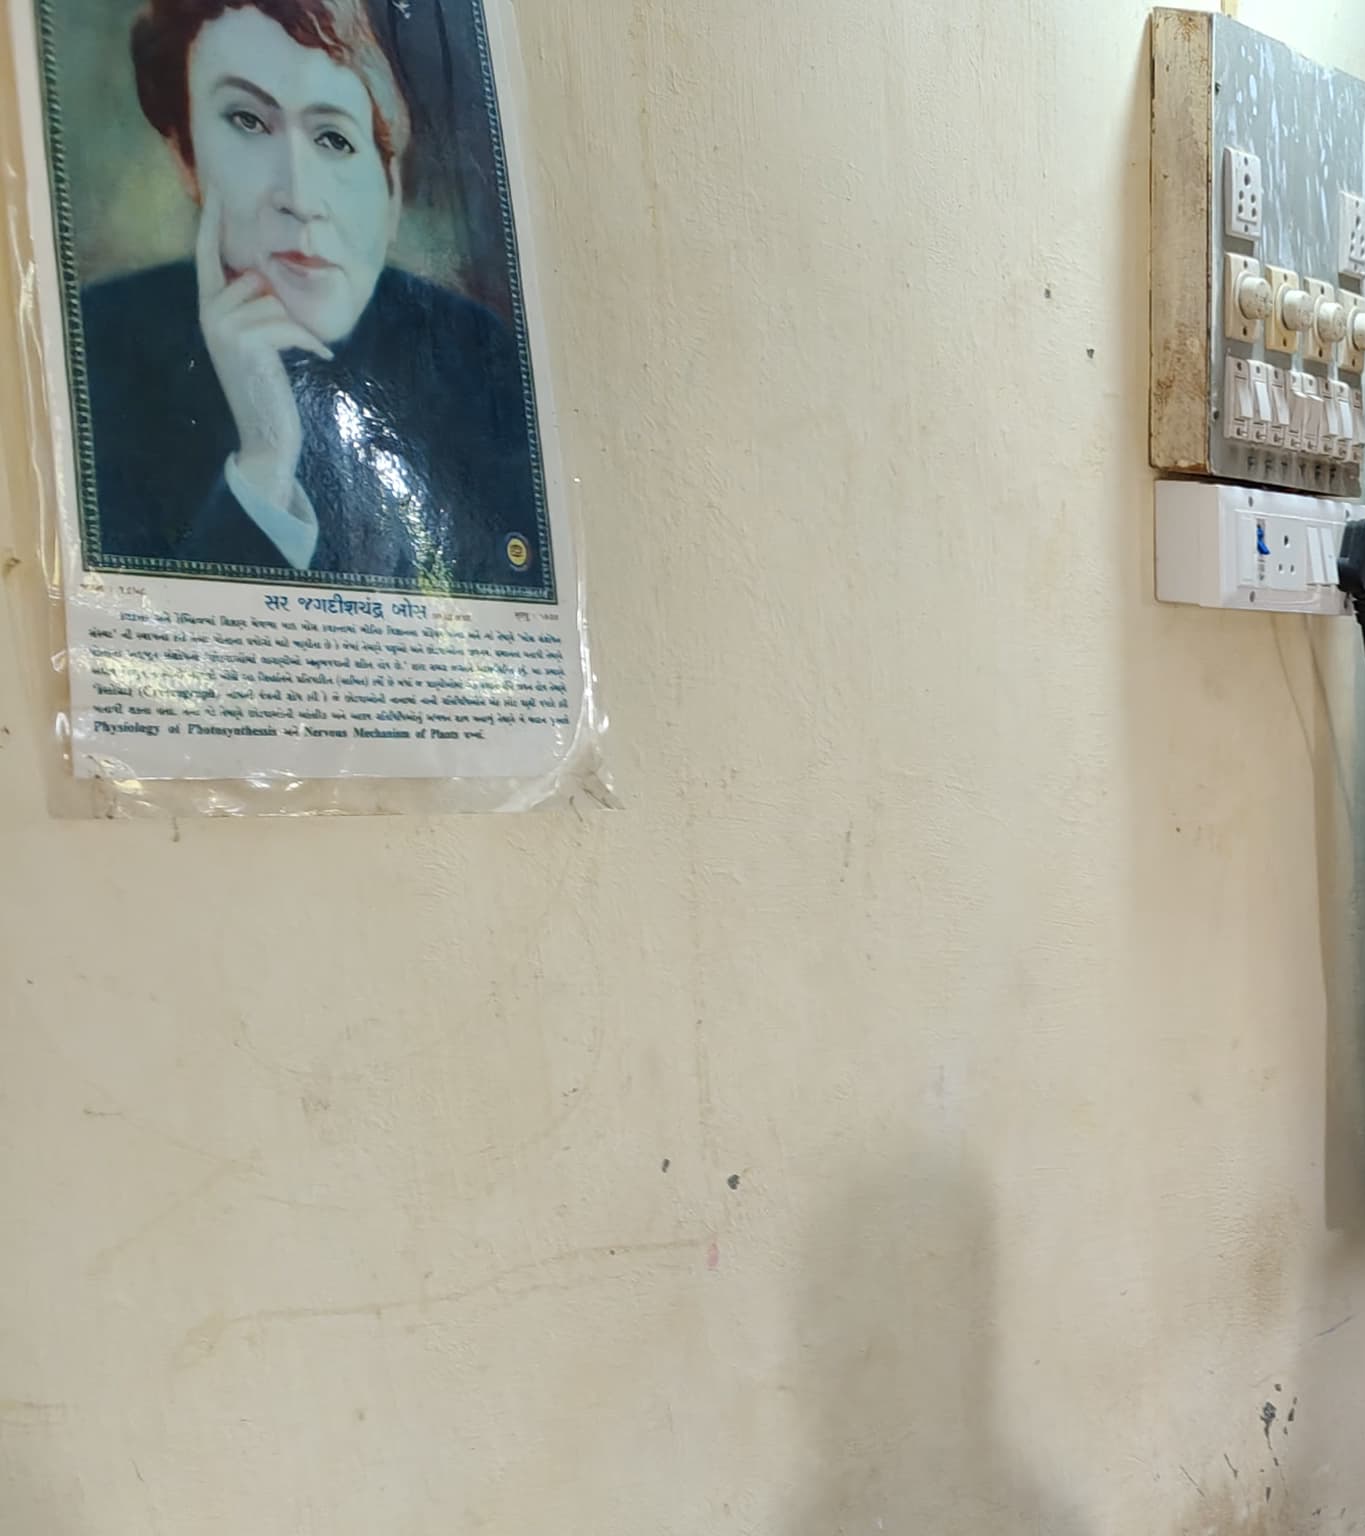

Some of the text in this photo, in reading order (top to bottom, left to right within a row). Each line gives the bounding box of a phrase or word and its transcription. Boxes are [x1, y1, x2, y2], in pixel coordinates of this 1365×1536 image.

[264, 594, 290, 612] સર
[297, 593, 385, 619] જગદીશચંદ્ર
[391, 597, 426, 620] બોસ
